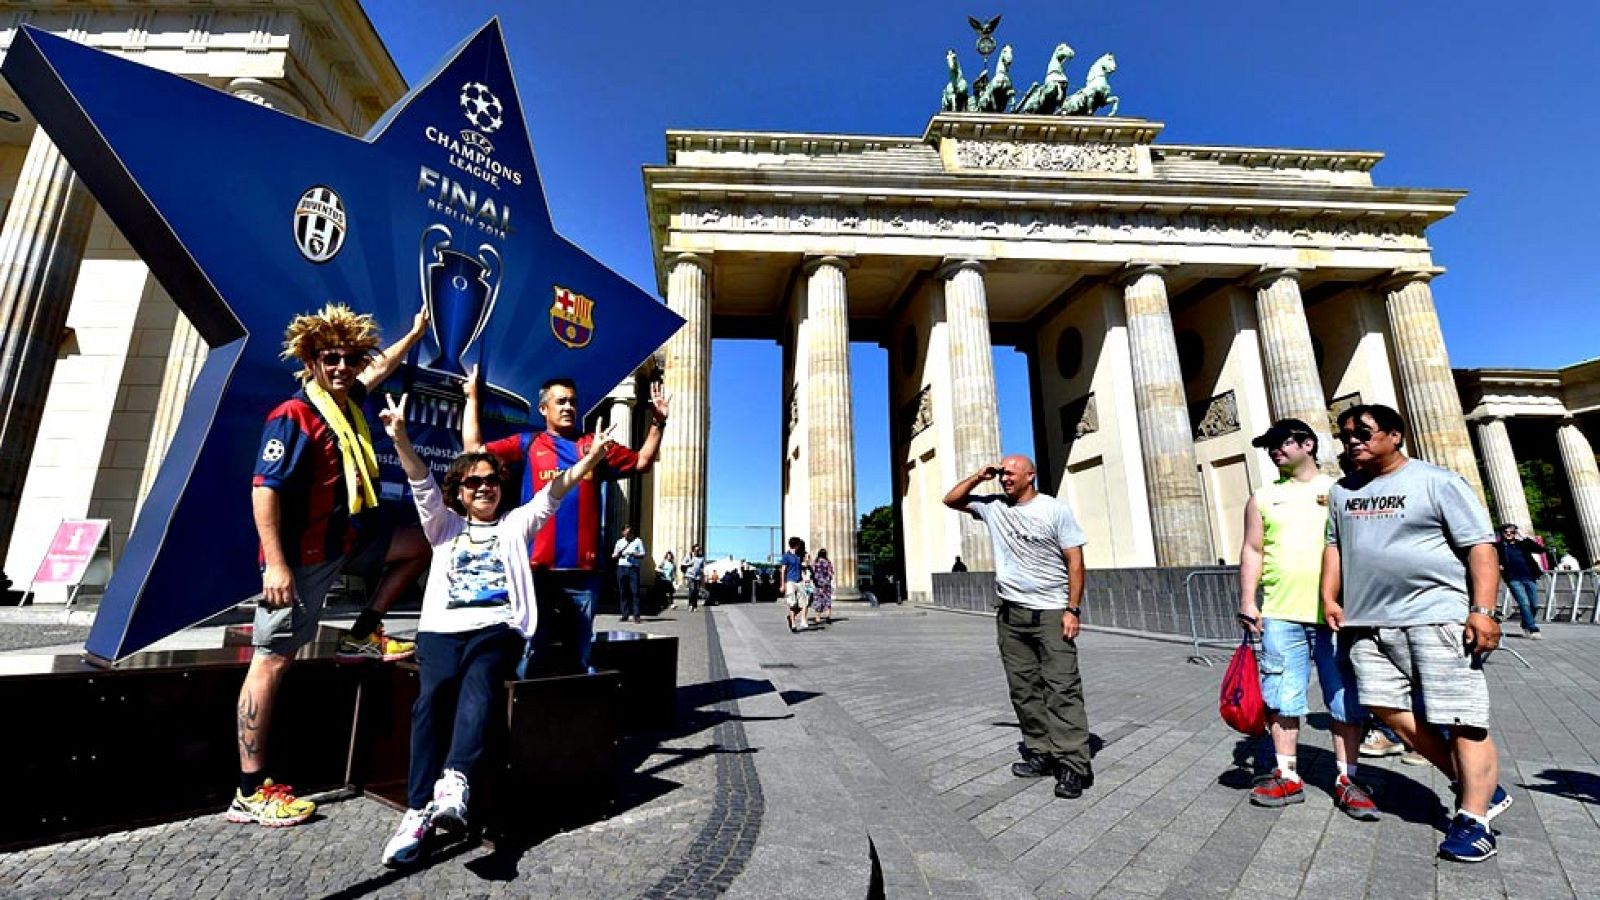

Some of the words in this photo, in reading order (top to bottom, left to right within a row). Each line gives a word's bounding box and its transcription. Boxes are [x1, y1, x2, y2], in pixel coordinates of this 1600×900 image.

[425, 126, 522, 186] CHAMPIONS
[461, 131, 492, 155] UEFA
[449, 154, 498, 186] LEAGUE
[418, 165, 513, 232] FINAL
[1344, 497, 1370, 511] NEW
[1370, 494, 1407, 510] YORK
